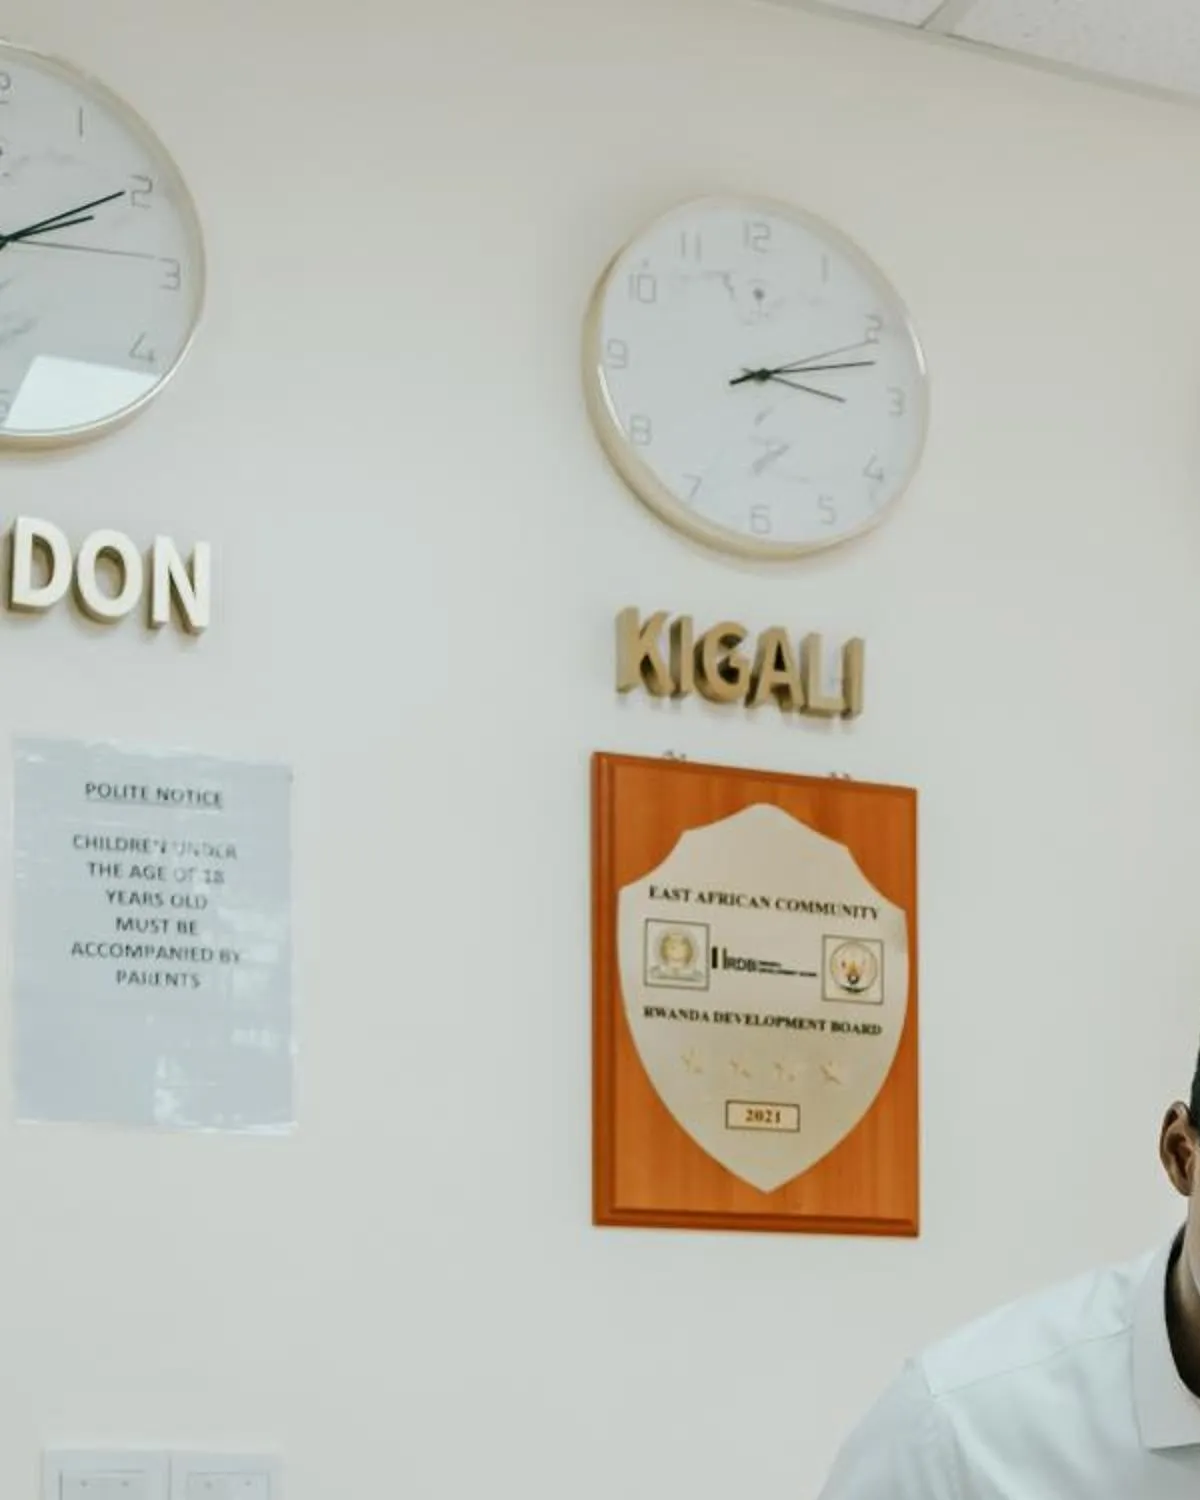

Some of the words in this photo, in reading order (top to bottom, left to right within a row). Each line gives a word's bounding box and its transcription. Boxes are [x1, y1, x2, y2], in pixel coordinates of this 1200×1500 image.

[129, 174, 153, 208] 2
[680, 231, 701, 260] 11
[743, 221, 771, 253] 12
[159, 257, 181, 291] 3
[629, 272, 656, 303] 10
[865, 315, 883, 345] 2
[129, 332, 156, 363] 4
[607, 339, 628, 369] 9
[887, 386, 906, 416] 3
[630, 415, 652, 446] 8
[862, 454, 884, 483] 4
[682, 473, 702, 498] 7
[750, 504, 771, 535] 6
[817, 495, 836, 525] 5
[615, 607, 864, 719] KIGALI
[85, 782, 149, 800] POLITE
[156, 787, 223, 808] NOTICE
[88, 862, 123, 879] THE
[129, 864, 168, 881] AGE
[174, 867, 197, 883] OF
[204, 869, 225, 884] 18
[106, 890, 164, 907] YEARS
[170, 894, 208, 910] OLD
[648, 884, 691, 903] EAST
[695, 890, 772, 909] AFRICAN
[775, 897, 880, 920] COMMUNITY
[116, 917, 169, 934] MUST
[177, 920, 198, 936] BE
[71, 942, 213, 962] ACCOMPANIED
[219, 949, 240, 964] BY
[116, 970, 201, 989] PARENTS
[643, 1005, 710, 1022] RWANDA
[714, 1011, 828, 1032] DEVELOPMENT
[830, 1020, 883, 1036] BOARD
[745, 1109, 782, 1124] 2021
